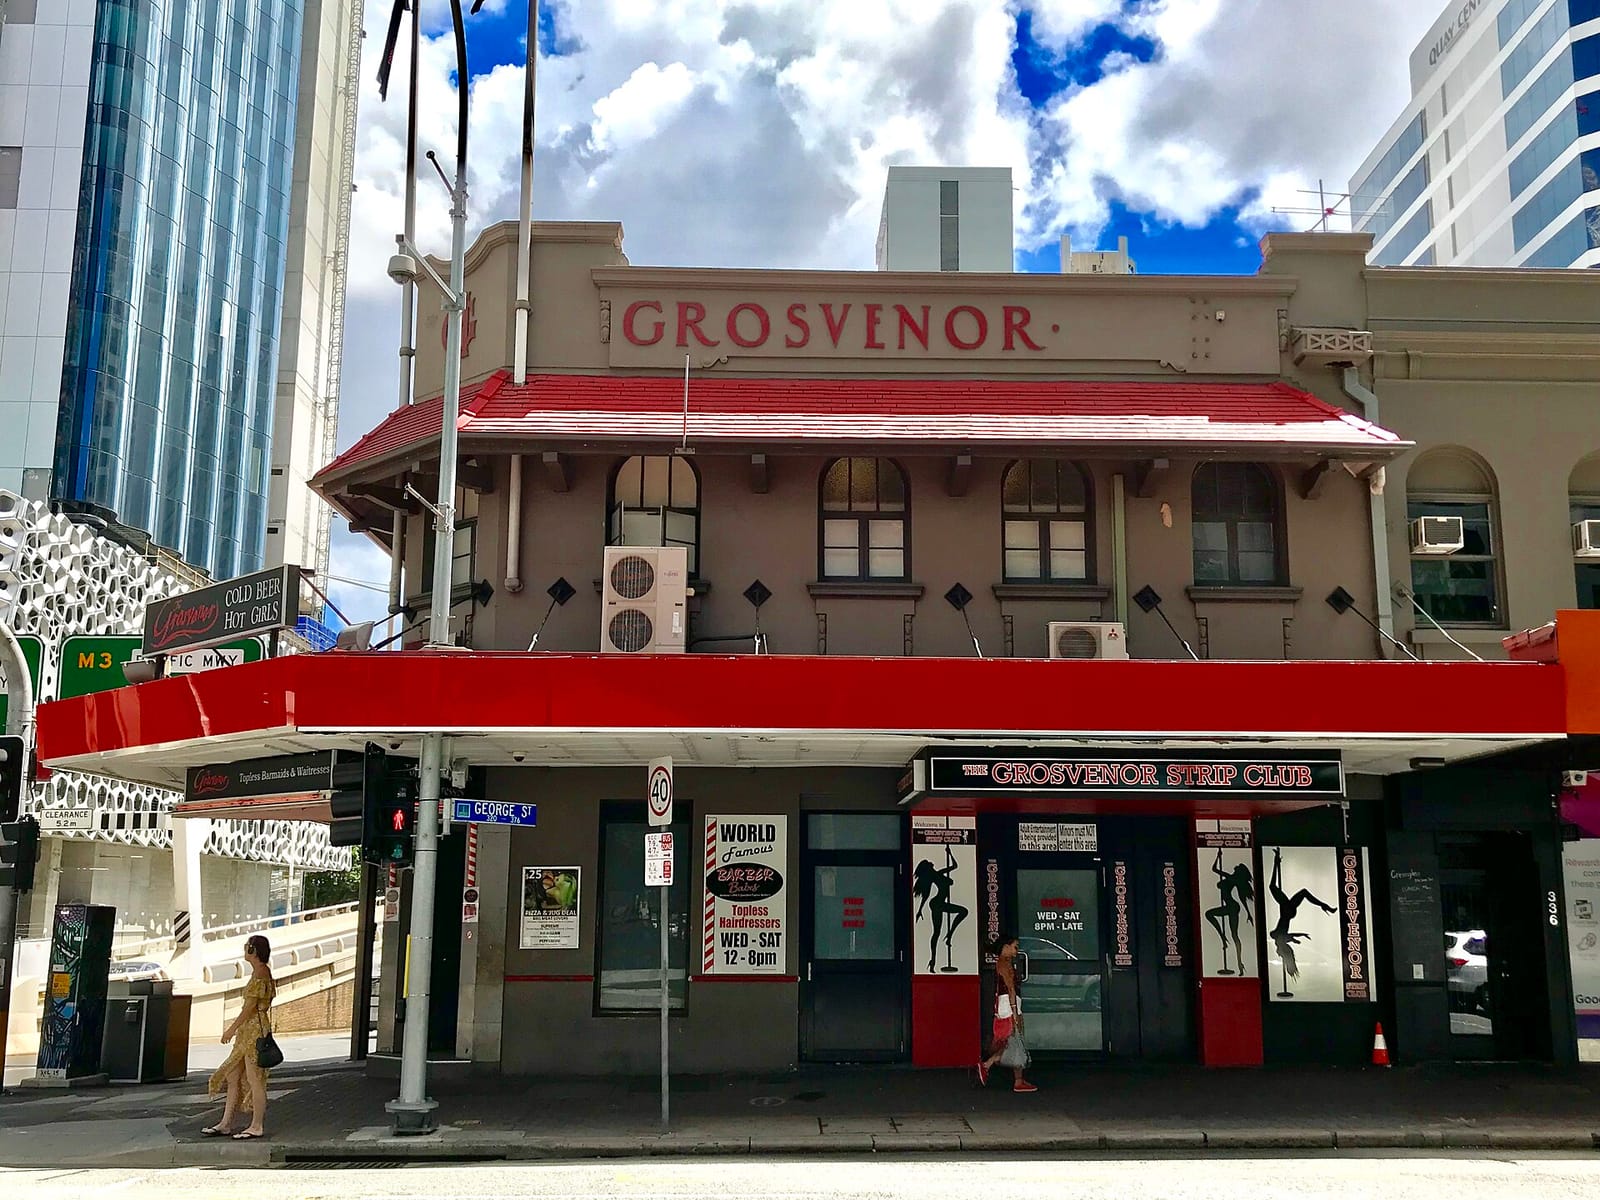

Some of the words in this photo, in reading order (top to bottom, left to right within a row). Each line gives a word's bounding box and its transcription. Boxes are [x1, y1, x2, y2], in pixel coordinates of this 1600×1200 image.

[1429, 21, 1455, 66] QUAY
[621, 300, 1047, 353] GROSVENOR
[225, 584, 252, 608] COLD
[256, 577, 281, 600] BEER
[223, 611, 247, 630] HOT
[250, 600, 279, 625] GIRLS
[239, 771, 261, 784] Topless
[261, 768, 290, 781] Barmaids
[290, 767, 296, 777] &
[296, 764, 330, 777] Waitresses
[962, 764, 988, 776] THE
[991, 762, 1159, 786] GROSVENOR
[1166, 764, 1238, 786] STRIP
[1243, 765, 1313, 788] CLUB
[651, 778, 669, 803] 40
[45, 811, 89, 819] CLEARANCE
[474, 801, 516, 817] GEORGE
[486, 814, 498, 822] 320
[510, 816, 521, 824] 376
[720, 823, 776, 843] WORLD
[721, 844, 774, 863] Famous
[731, 904, 769, 918] Topless
[986, 863, 1000, 943] GROSVENO
[1114, 865, 1129, 954] GROSVENOR
[1163, 867, 1179, 955] GROSVENOR
[1547, 890, 1559, 926] 336
[719, 916, 781, 929] Hairdressers
[1036, 911, 1058, 921] WED
[1063, 911, 1081, 921] SAT
[1342, 855, 1363, 980] GROSVENOR
[1034, 922, 1055, 931] 8PM
[1061, 922, 1084, 931] LATE
[720, 932, 749, 948] WED
[758, 932, 782, 948] SAT
[723, 949, 738, 965] 12
[748, 949, 777, 967] 8pm
